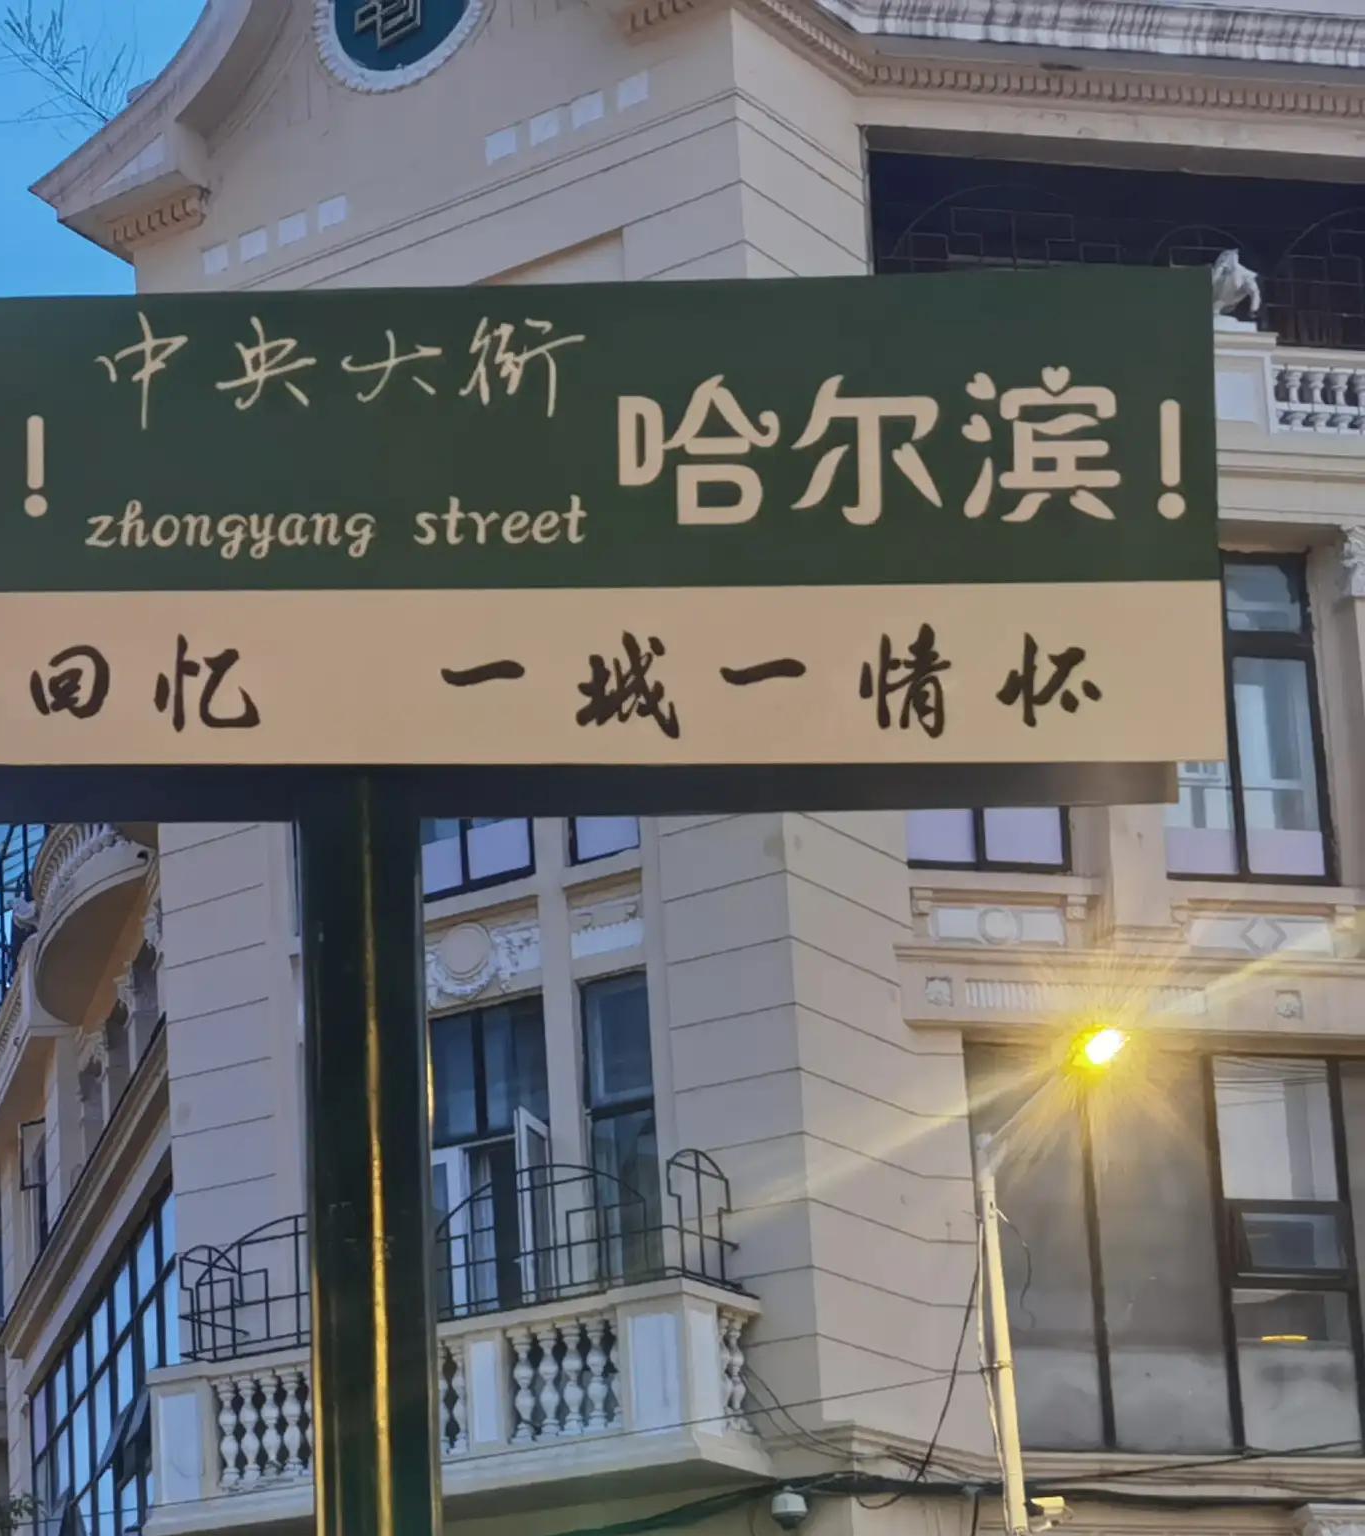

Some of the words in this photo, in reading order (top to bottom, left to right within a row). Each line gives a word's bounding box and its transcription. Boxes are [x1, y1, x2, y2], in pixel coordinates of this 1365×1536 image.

[95, 311, 585, 431] 中央大街
[617, 365, 1187, 526] 哈尔滨！
[84, 499, 377, 560] zhongyang
[413, 494, 589, 546] street
[440, 622, 1103, 740] 一城一情怀
